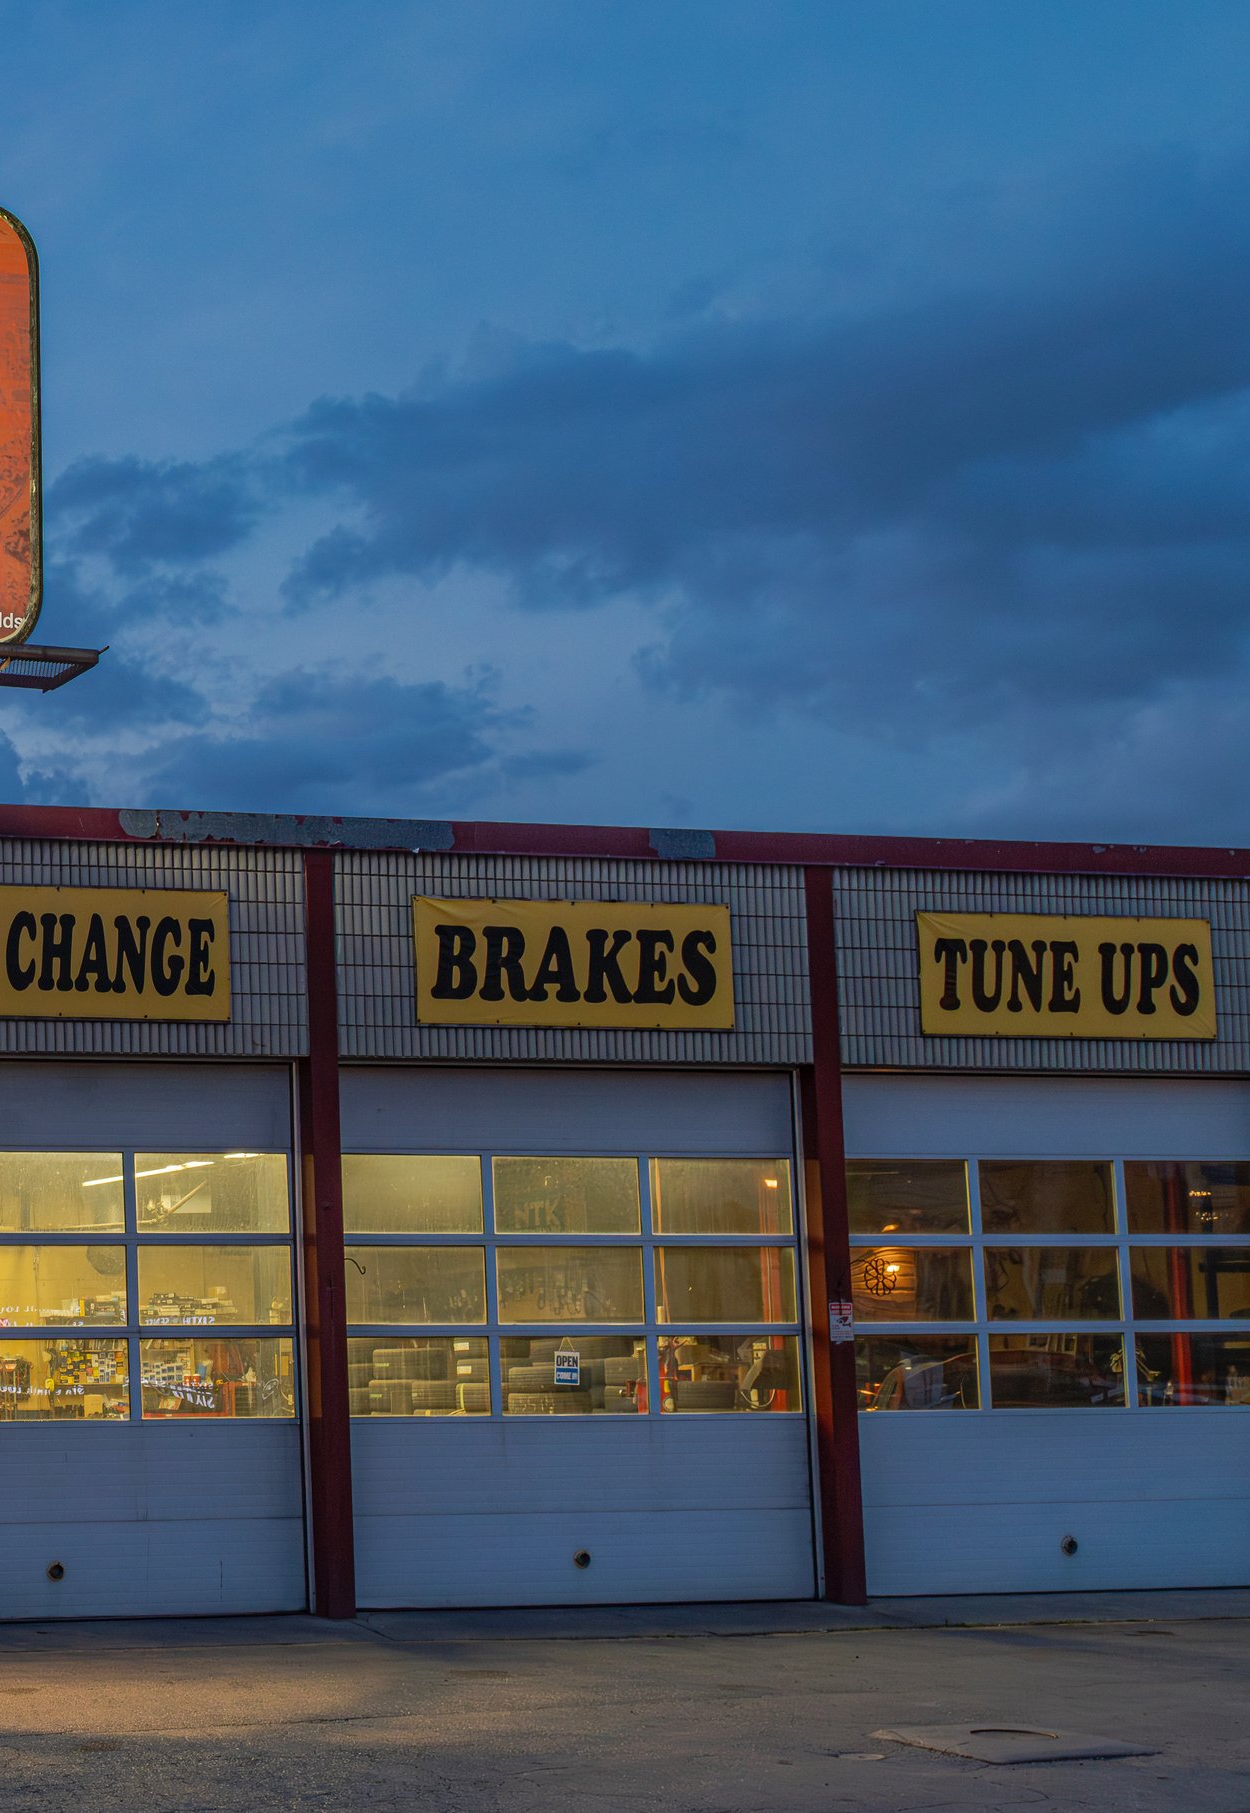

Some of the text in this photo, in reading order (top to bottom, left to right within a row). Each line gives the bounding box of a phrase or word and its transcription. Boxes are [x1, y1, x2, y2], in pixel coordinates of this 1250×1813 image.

[5, 910, 216, 997] CHANGE
[430, 924, 717, 1007] BRAKES
[934, 937, 1200, 1017] TUNE UPS
[556, 1355, 578, 1367] OPEN
